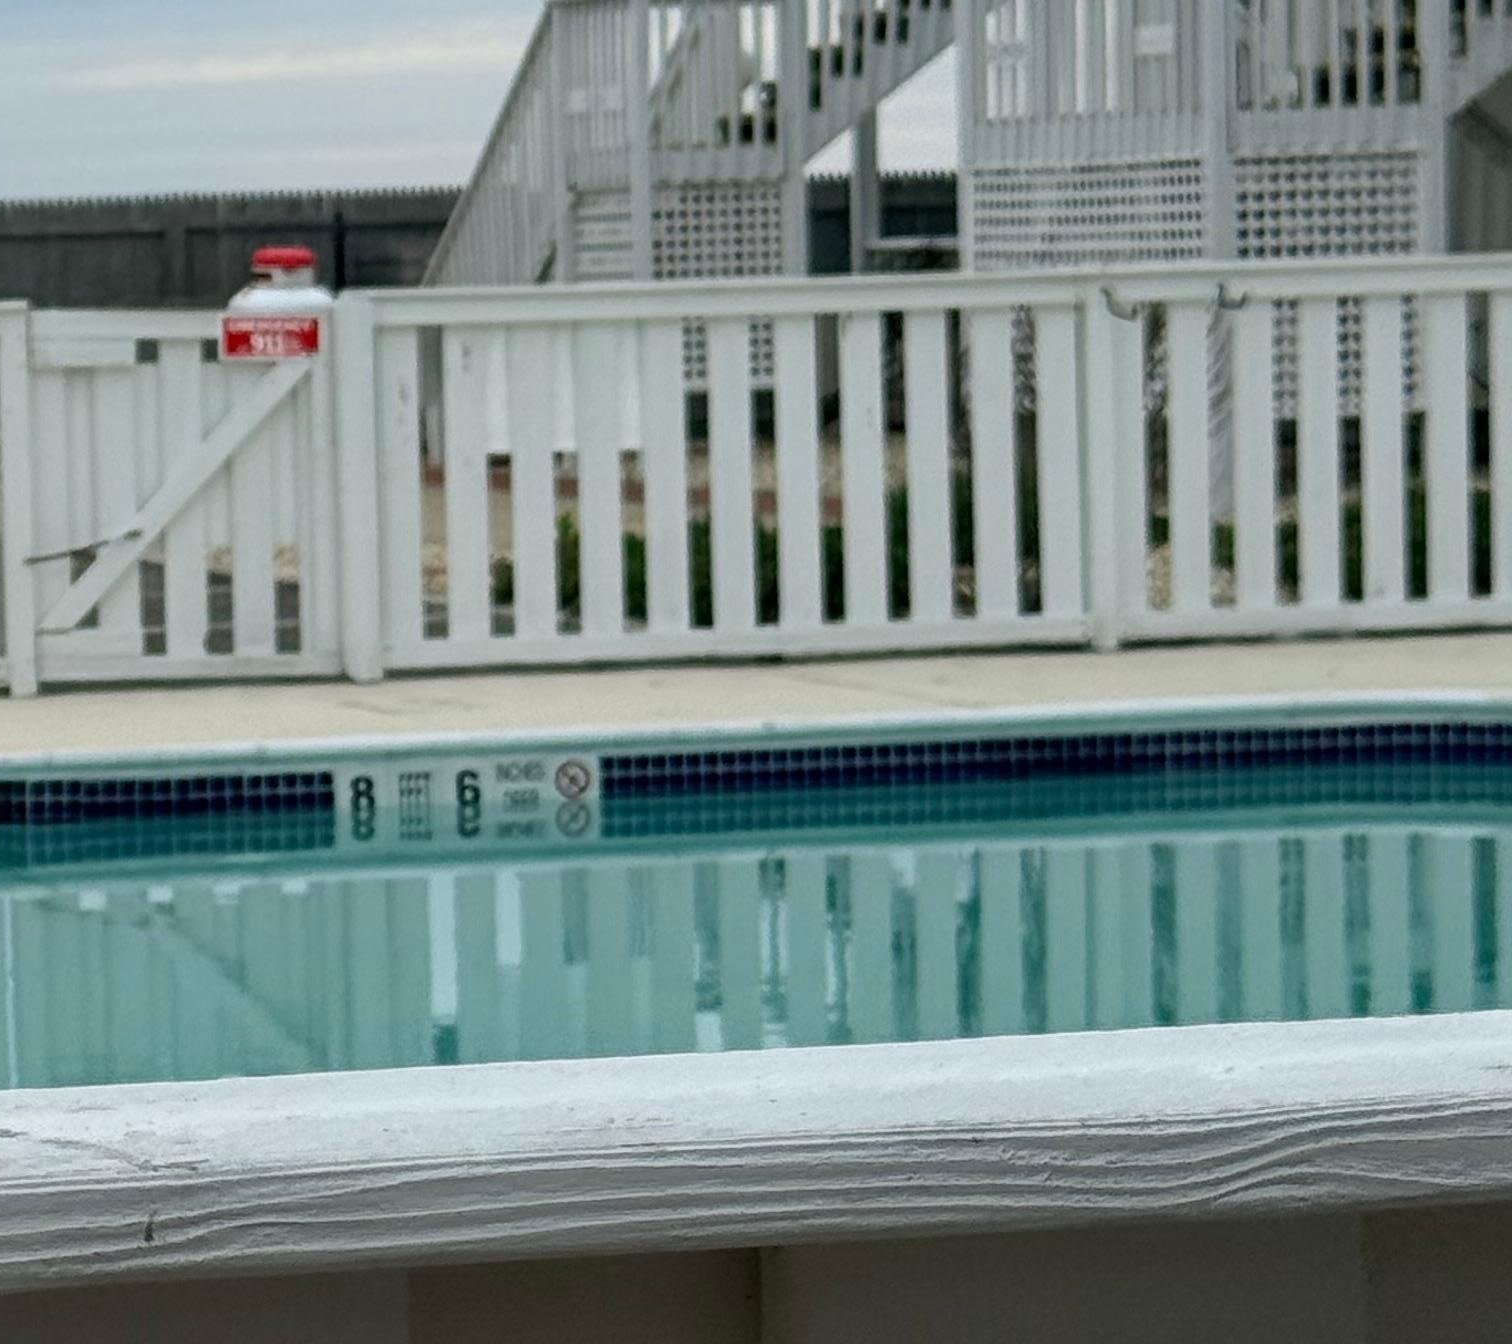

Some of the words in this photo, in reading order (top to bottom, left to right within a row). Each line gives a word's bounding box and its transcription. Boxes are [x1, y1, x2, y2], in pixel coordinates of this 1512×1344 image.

[251, 332, 285, 355] 911
[350, 776, 375, 808] 8
[456, 769, 481, 806] 6
